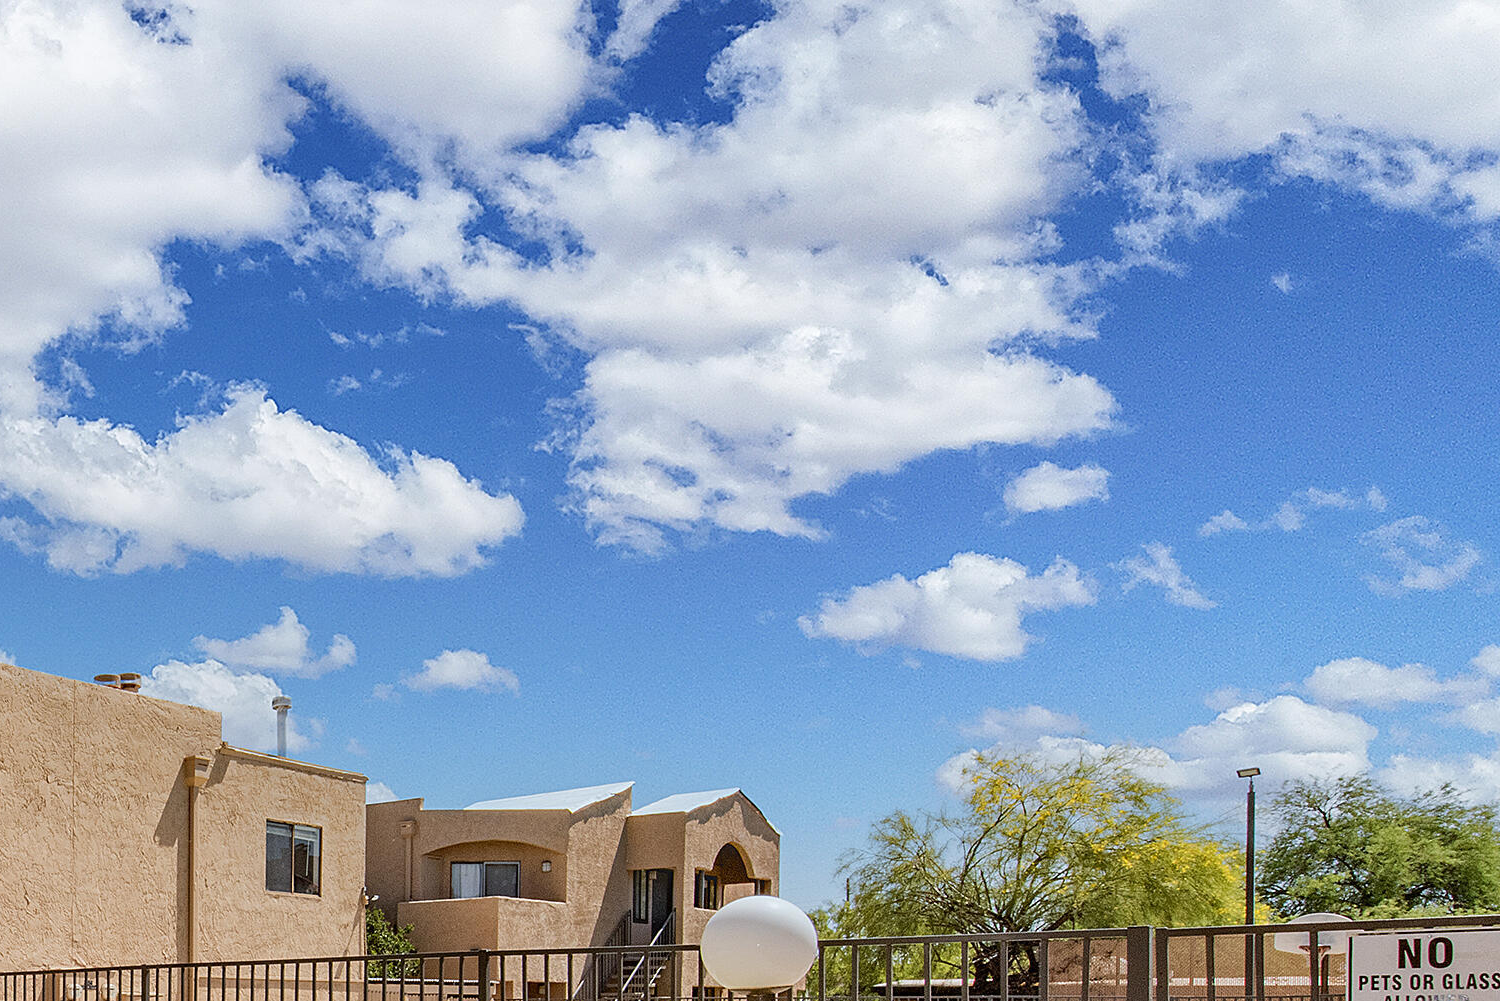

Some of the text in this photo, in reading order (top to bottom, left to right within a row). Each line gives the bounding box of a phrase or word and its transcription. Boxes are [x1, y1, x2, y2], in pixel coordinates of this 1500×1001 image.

[1398, 937, 1453, 969] NO
[1358, 973, 1500, 991] PETS OR GLASS
